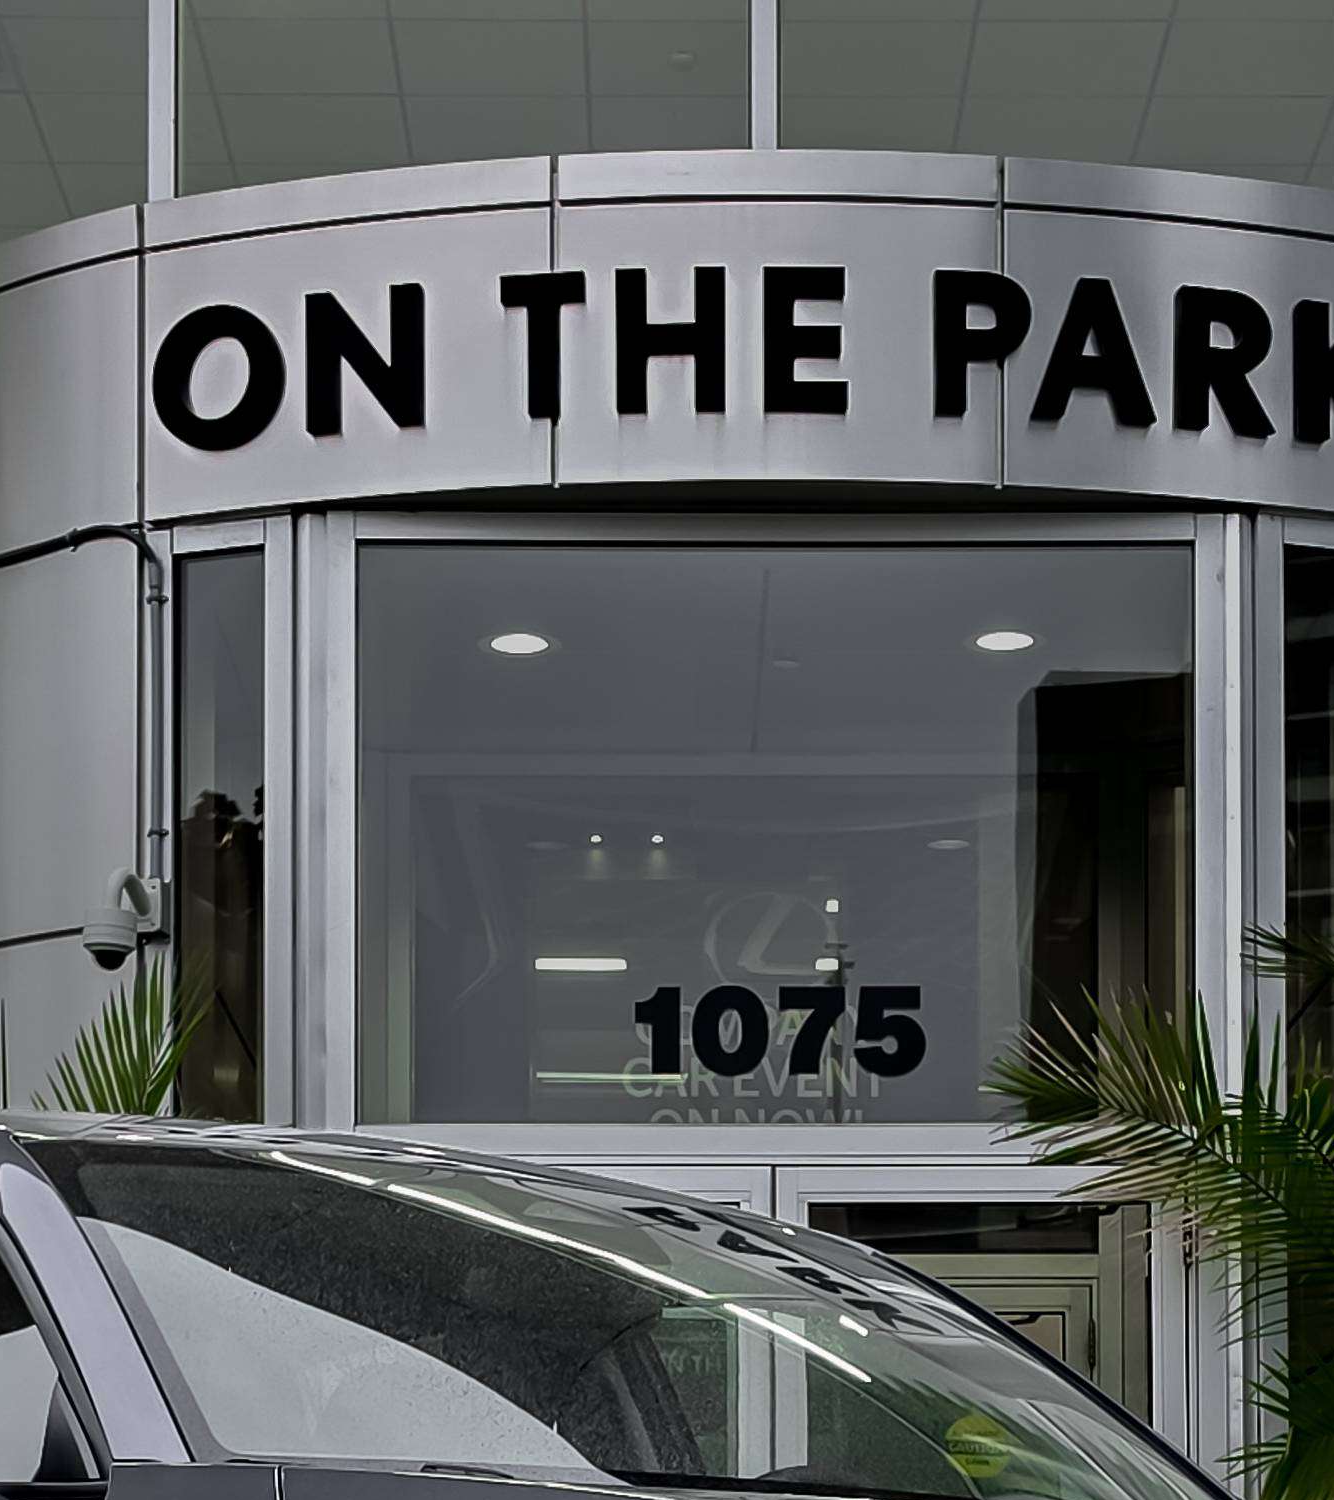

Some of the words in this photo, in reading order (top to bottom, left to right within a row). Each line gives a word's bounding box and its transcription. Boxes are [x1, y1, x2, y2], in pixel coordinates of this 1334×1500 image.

[152, 283, 426, 453] ON
[499, 266, 849, 420] THE
[634, 985, 927, 1077] 1075
